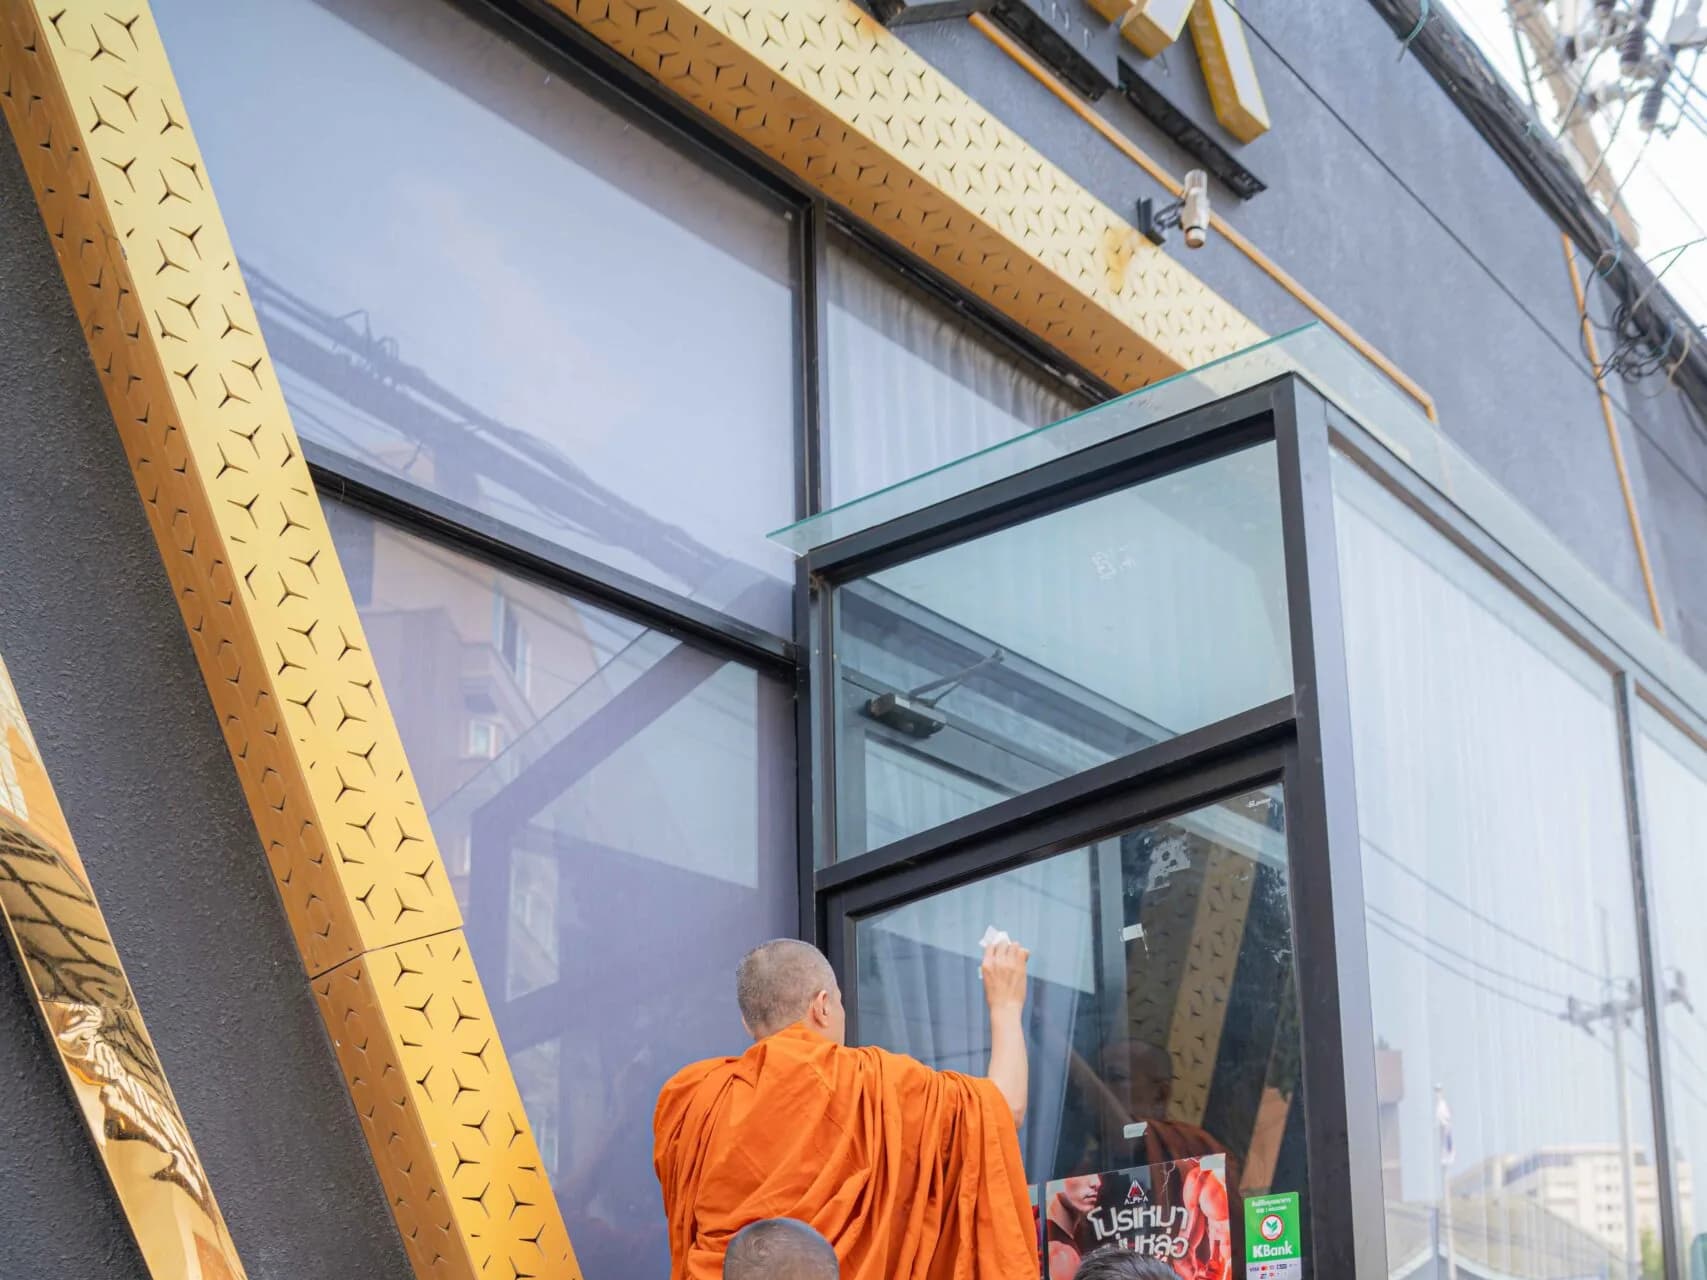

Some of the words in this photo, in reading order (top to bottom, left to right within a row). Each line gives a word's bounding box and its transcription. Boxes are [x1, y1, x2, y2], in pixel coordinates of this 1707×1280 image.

[1086, 1205, 1189, 1240] โปรเหมา
[1252, 1240, 1293, 1259] KBank
